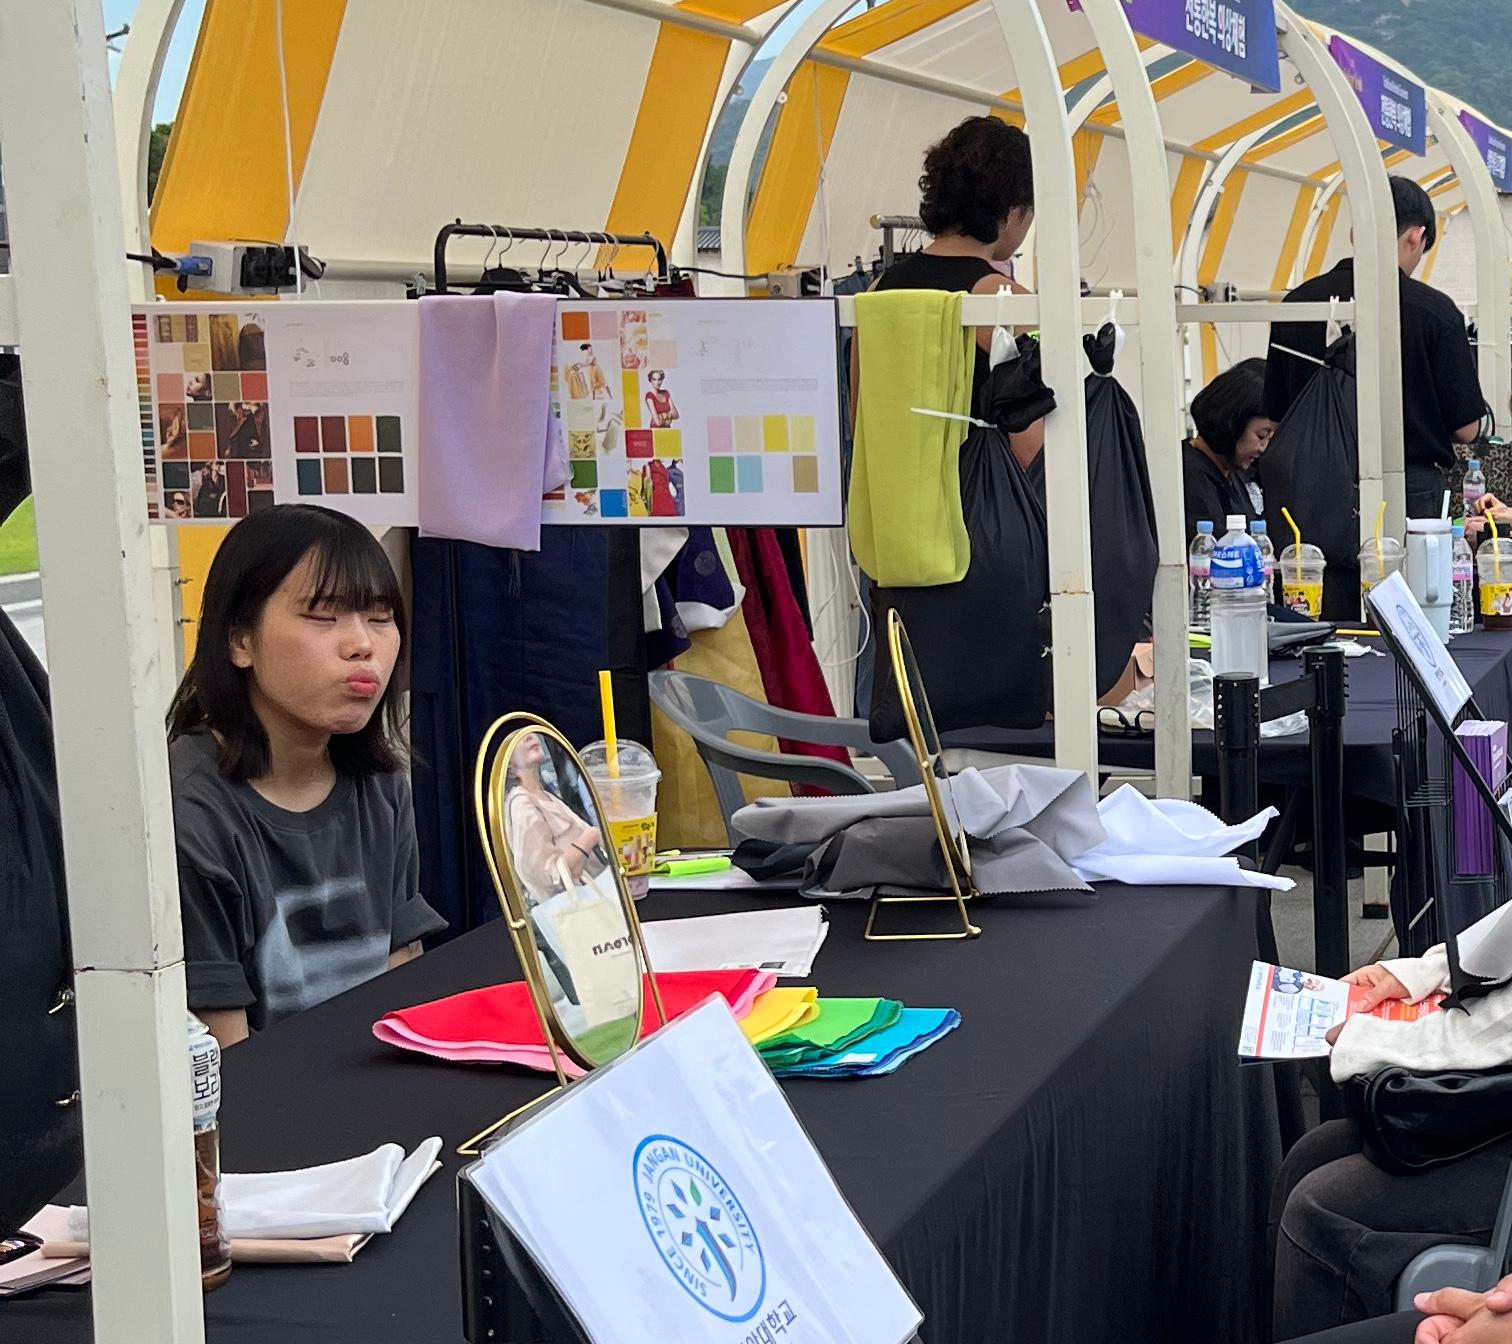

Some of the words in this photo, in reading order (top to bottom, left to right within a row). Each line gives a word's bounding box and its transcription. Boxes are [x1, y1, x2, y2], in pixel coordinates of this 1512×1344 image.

[1217, 4, 1247, 59] 의상체험
[642, 1146, 681, 1183] JANGAN
[684, 1152, 757, 1255] UNIVERSITY
[643, 1191, 667, 1238] 1979
[666, 1246, 708, 1298] SINCE
